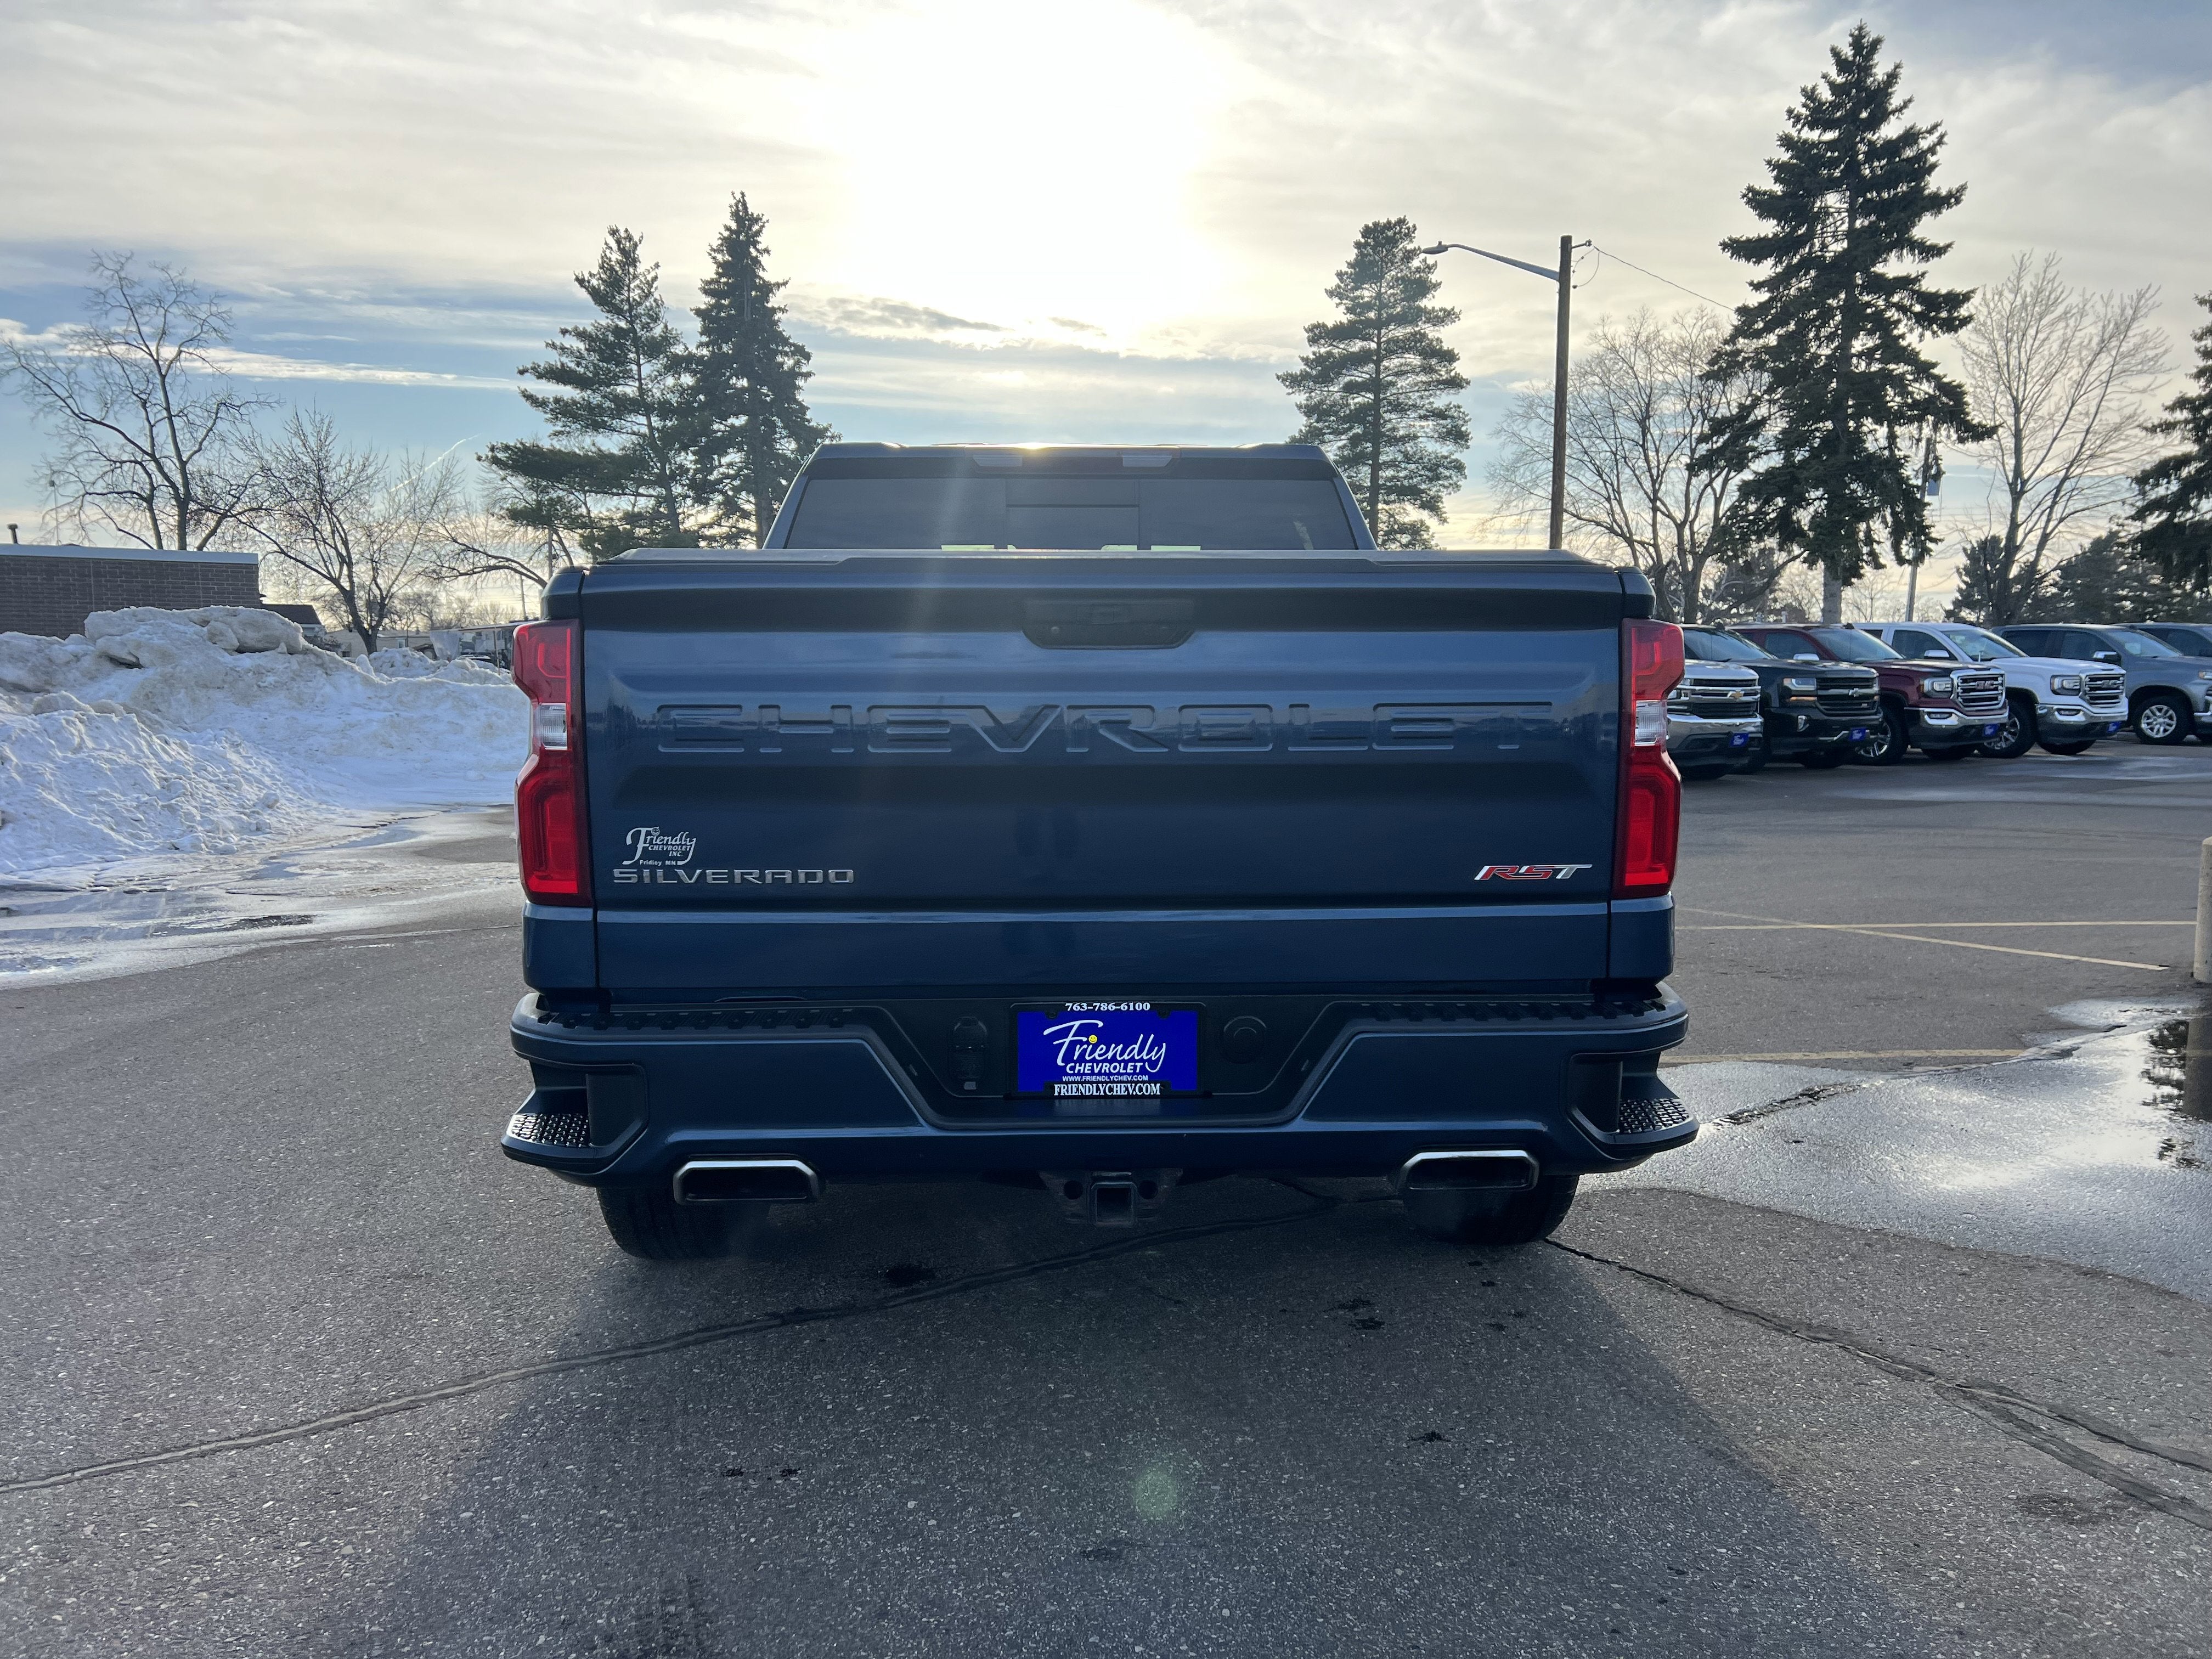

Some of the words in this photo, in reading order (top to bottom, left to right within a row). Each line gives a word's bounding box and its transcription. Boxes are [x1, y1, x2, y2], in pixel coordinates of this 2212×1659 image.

[657, 702, 1553, 753] CHEVROLET
[622, 826, 697, 865] Friendly
[612, 868, 855, 884] SILVERADO
[1474, 864, 1593, 881] RST
[1065, 1002, 1151, 1012] 763-786-6100
[1043, 1019, 1166, 1073] Friendly
[1066, 1063, 1144, 1074] CHEVROLET
[1053, 1084, 1161, 1096] FRIENDLYCHEV.COM
